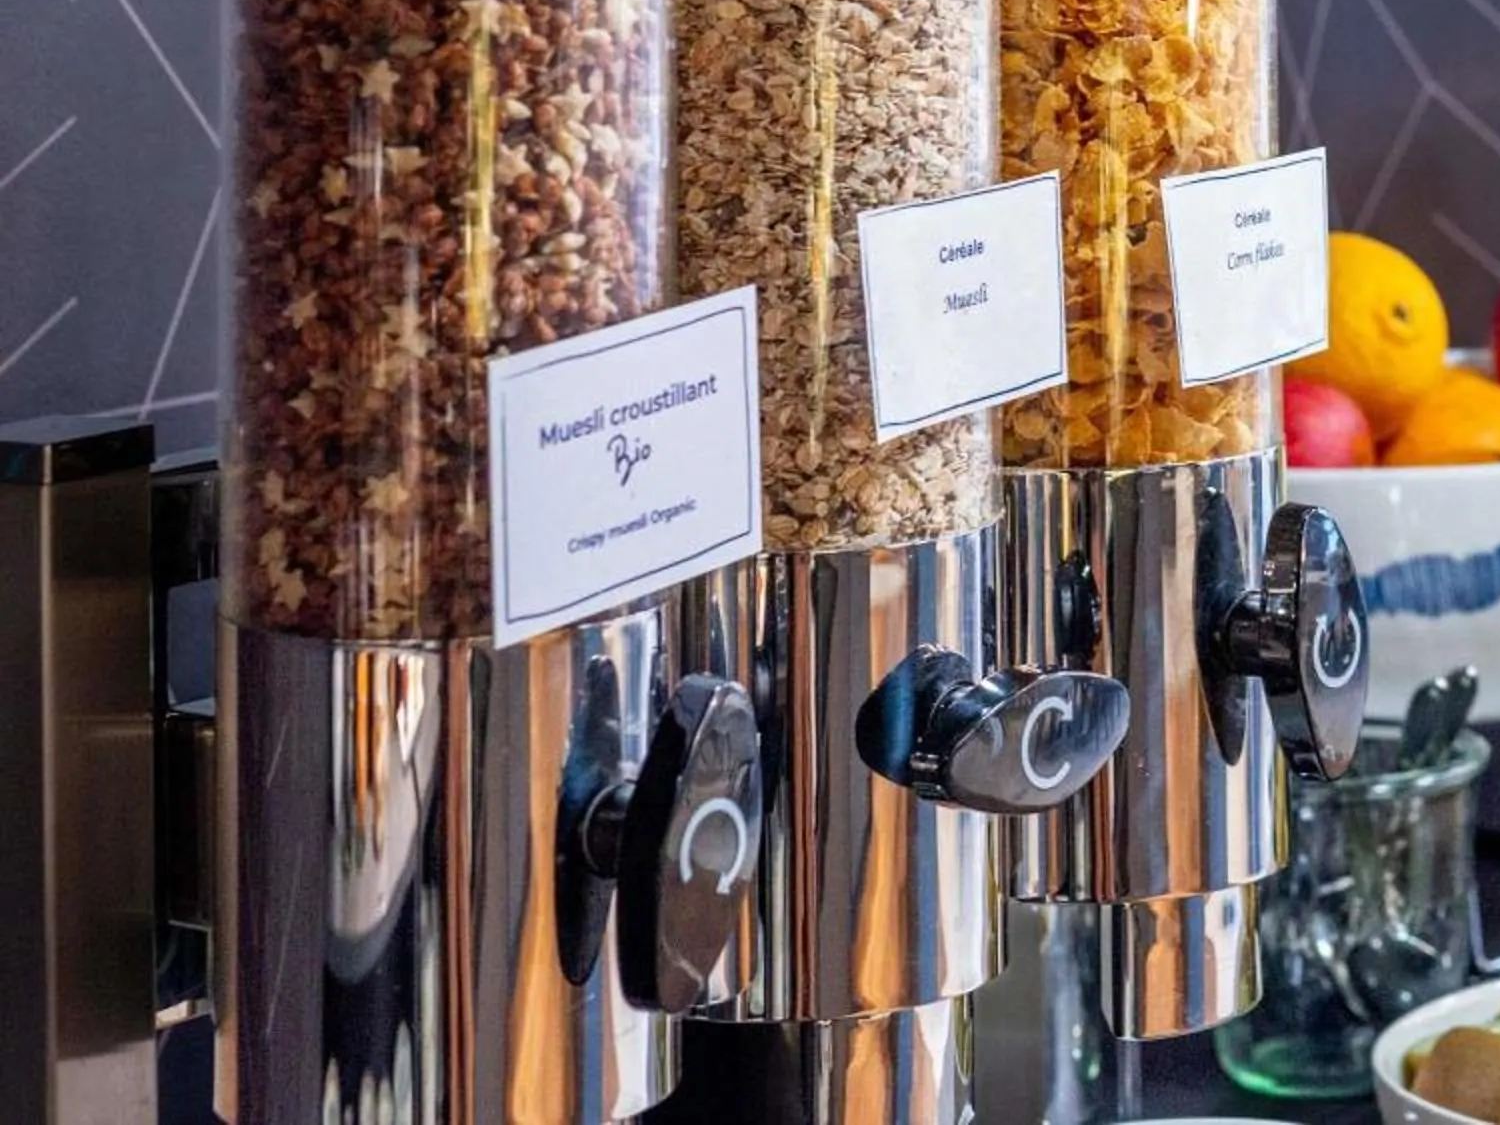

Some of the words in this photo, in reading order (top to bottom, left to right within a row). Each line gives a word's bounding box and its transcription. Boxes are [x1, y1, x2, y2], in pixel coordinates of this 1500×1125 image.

[538, 405, 605, 450] Muesli
[609, 373, 717, 426] croustillant
[606, 432, 653, 487] Bio
[650, 496, 697, 524] Organic
